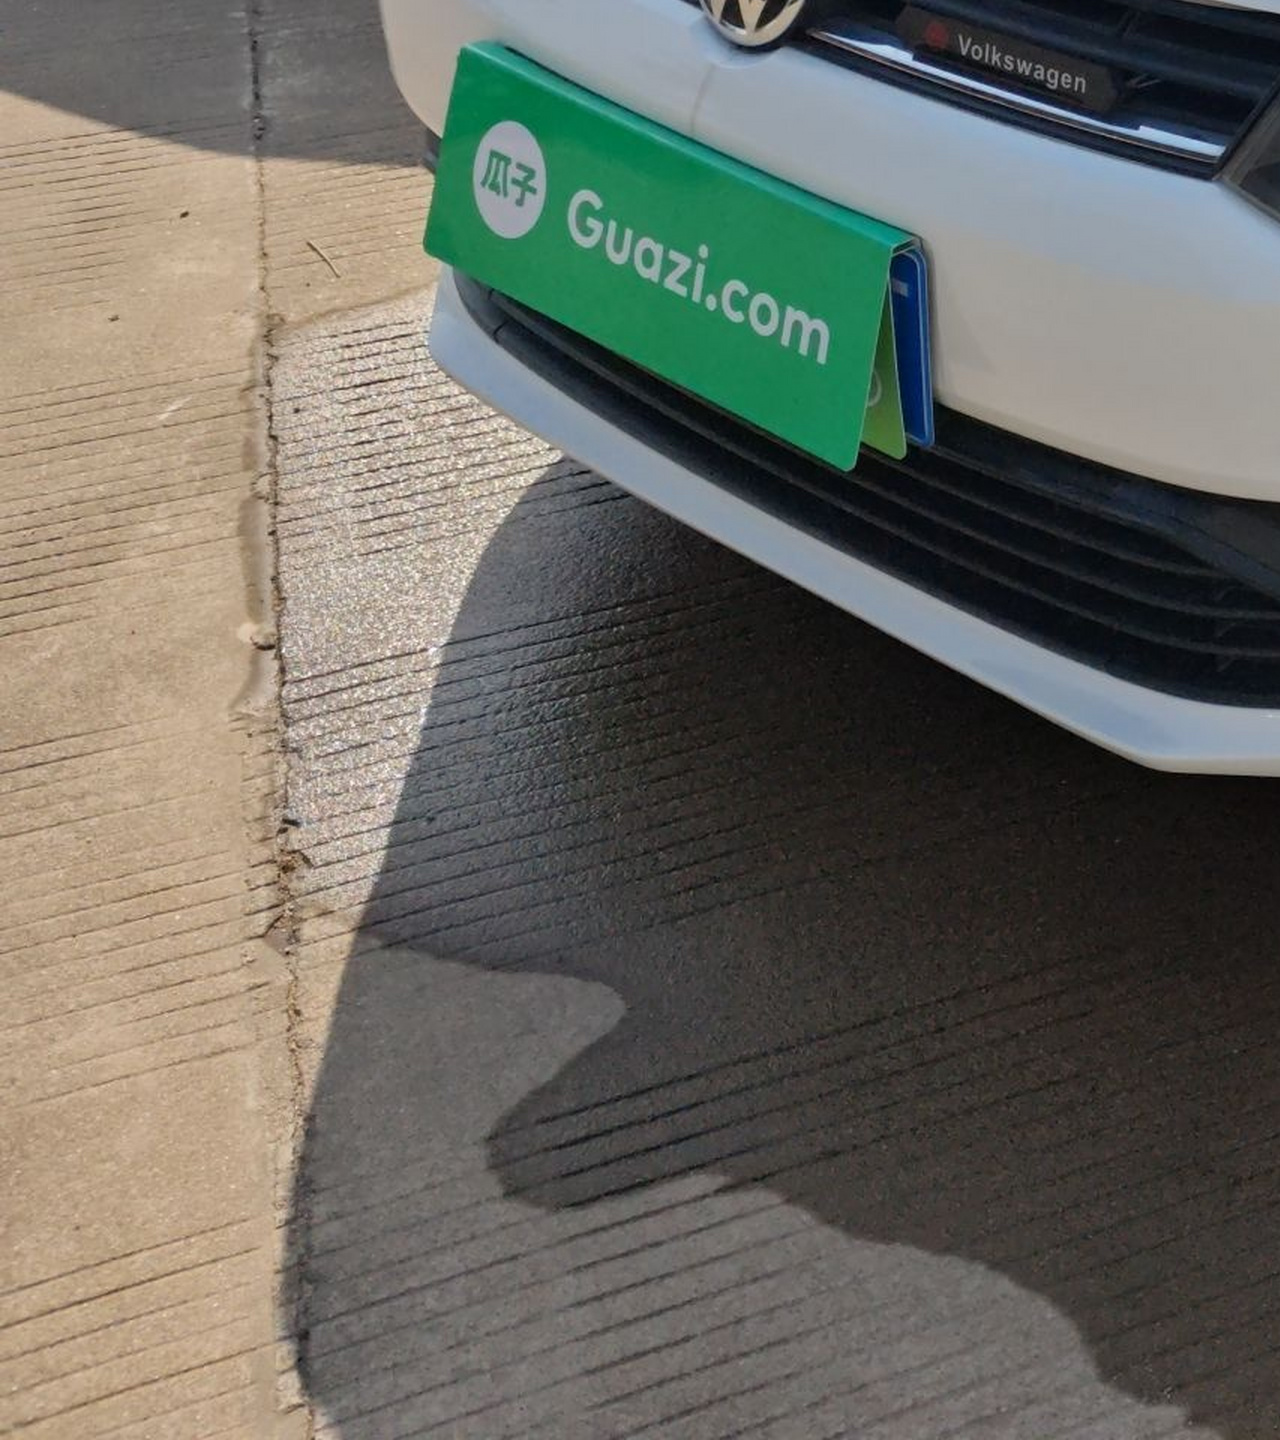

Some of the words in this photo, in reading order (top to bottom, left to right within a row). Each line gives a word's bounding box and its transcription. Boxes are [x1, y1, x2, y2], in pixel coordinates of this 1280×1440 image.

[957, 34, 1087, 94] Volkswagen
[480, 149, 537, 208] 瓜子
[567, 189, 830, 365] Guazi.com
